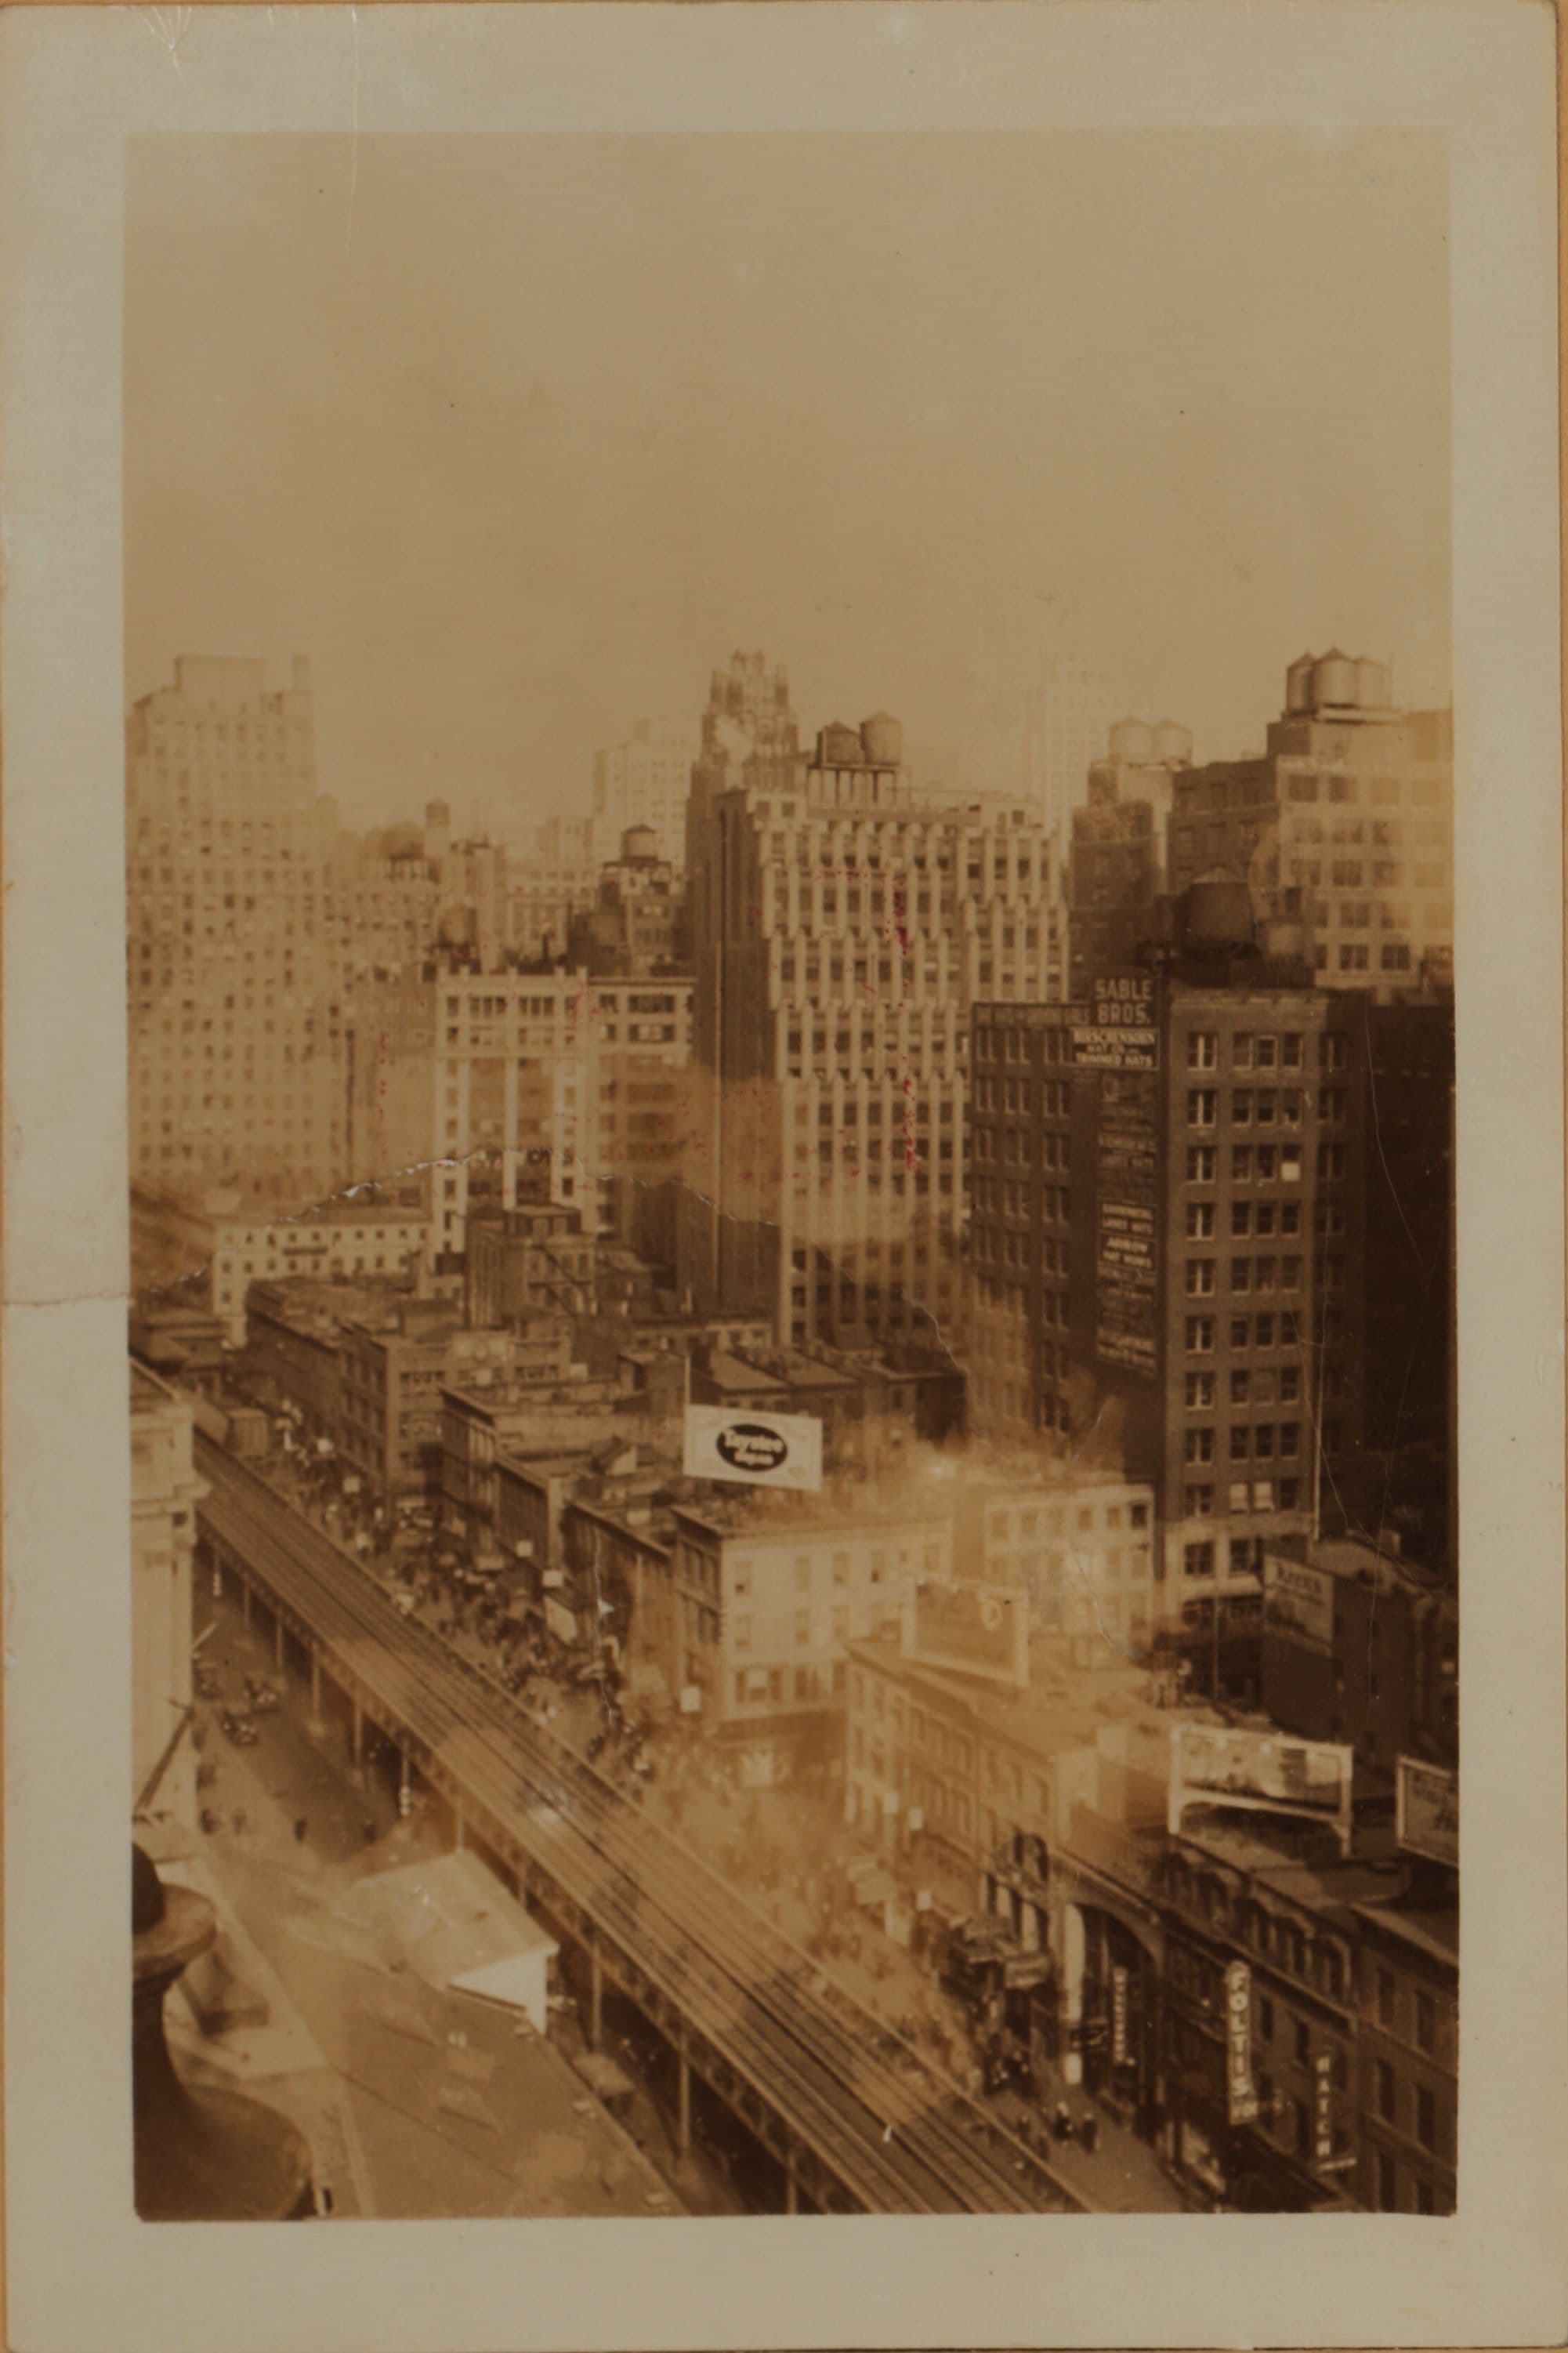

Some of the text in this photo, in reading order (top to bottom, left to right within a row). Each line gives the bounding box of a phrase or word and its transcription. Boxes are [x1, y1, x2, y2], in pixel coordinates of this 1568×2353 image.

[1095, 978, 1153, 1002] SABLE
[1098, 1002, 1152, 1025] BROS.
[1229, 1970, 1249, 2096] FOLTIS
